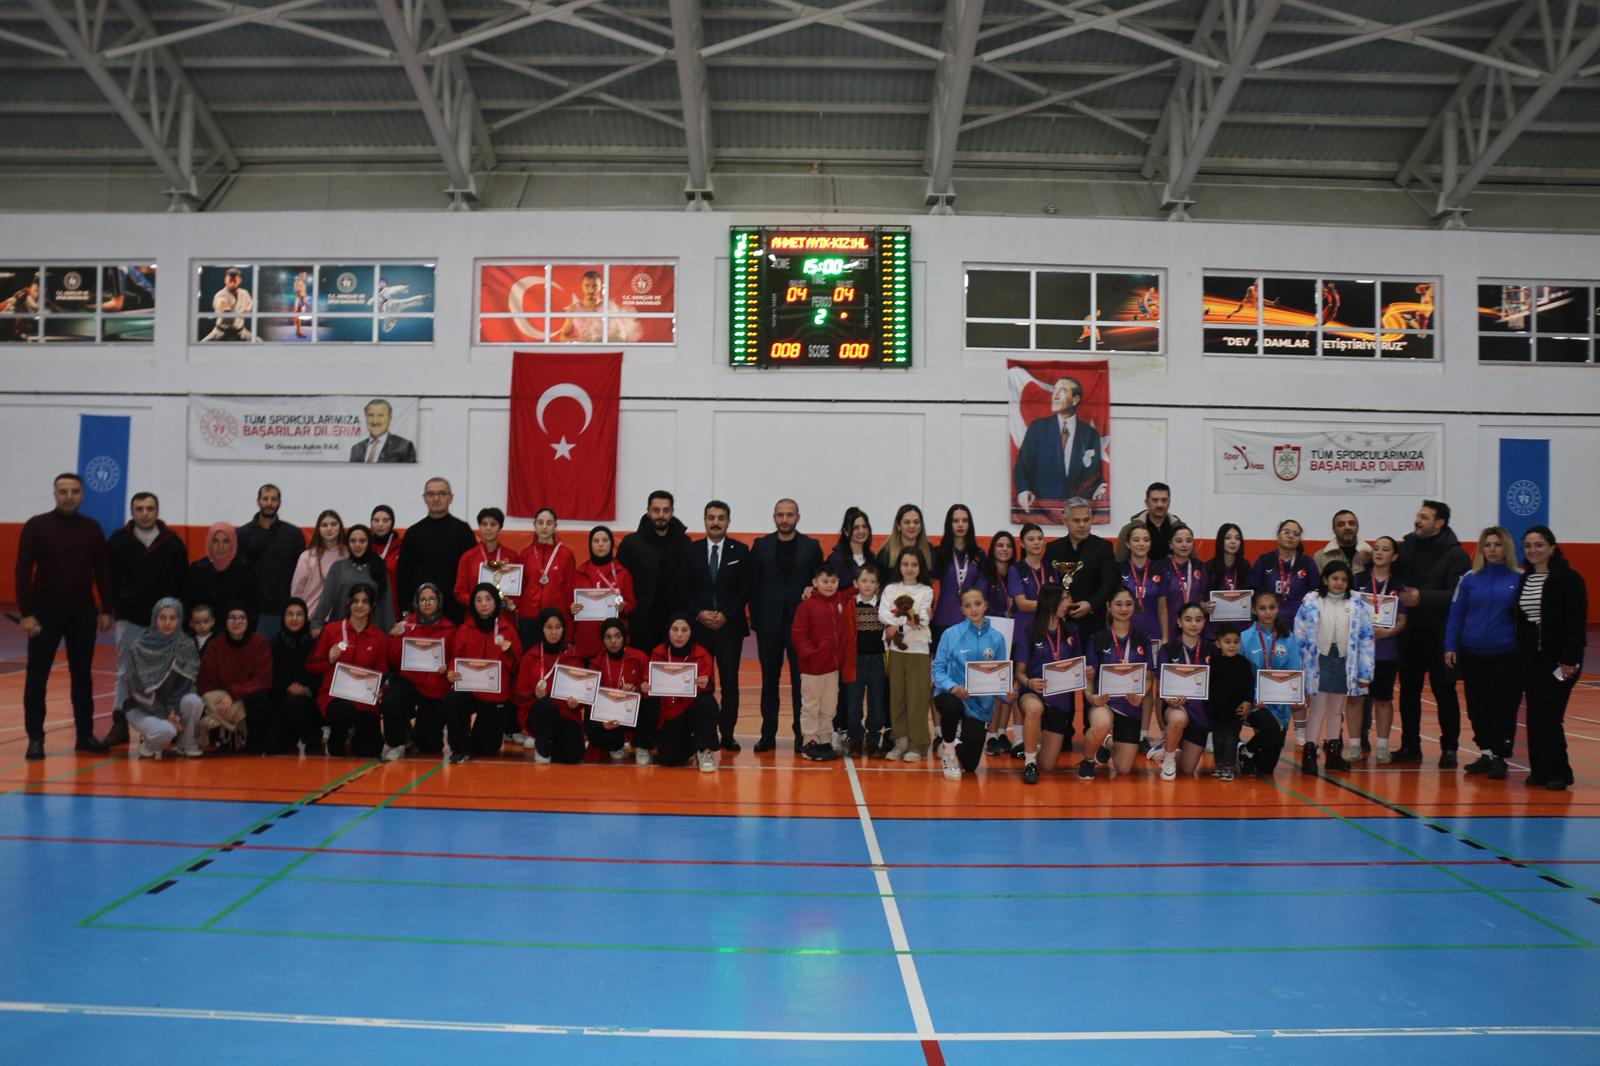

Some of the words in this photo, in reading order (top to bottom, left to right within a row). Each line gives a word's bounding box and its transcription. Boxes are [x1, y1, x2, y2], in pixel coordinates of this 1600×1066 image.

[803, 258, 844, 274] 15:00
[787, 287, 807, 302] 04
[834, 287, 855, 302] 04
[814, 308, 827, 325] 2
[771, 343, 801, 358] 008
[808, 345, 829, 358] SCORE
[839, 343, 870, 358] 000
[269, 415, 360, 425] SPORCULARIMIZA
[243, 425, 310, 437] BAŞARILAR
[1311, 448, 1333, 459] TÜM
[1336, 450, 1424, 460] SPORCULARIMIZA
[1310, 460, 1376, 473] BAŞARILAR
[1379, 461, 1425, 471] DİLERİM
